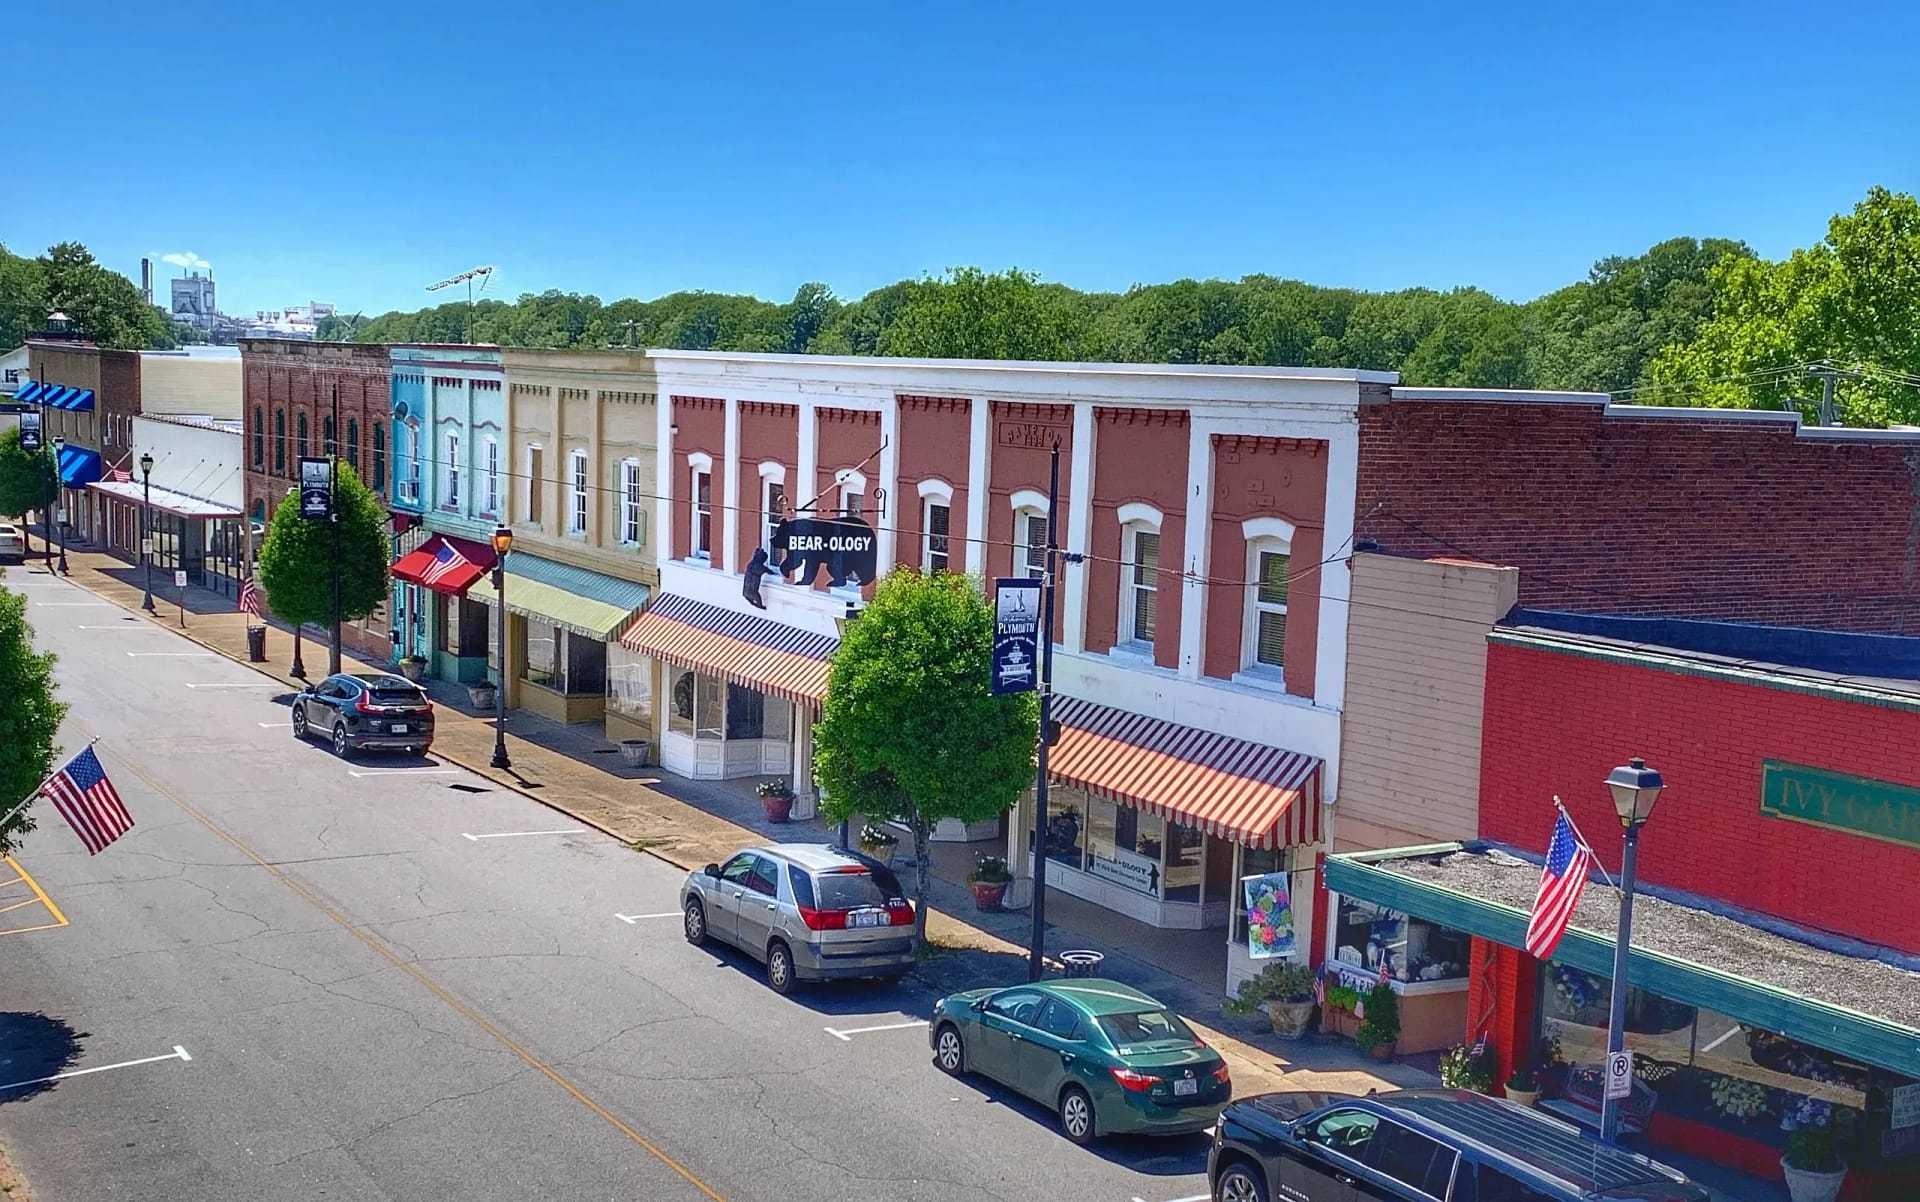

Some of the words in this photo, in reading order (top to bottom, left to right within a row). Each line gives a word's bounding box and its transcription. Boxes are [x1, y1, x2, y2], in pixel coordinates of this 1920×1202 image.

[1007, 424, 1063, 446] HAMPTON
[789, 535, 871, 551] BEAR-OLOGY
[998, 622, 1035, 635] PLYMOUTH
[1780, 777, 1837, 817] IVY
